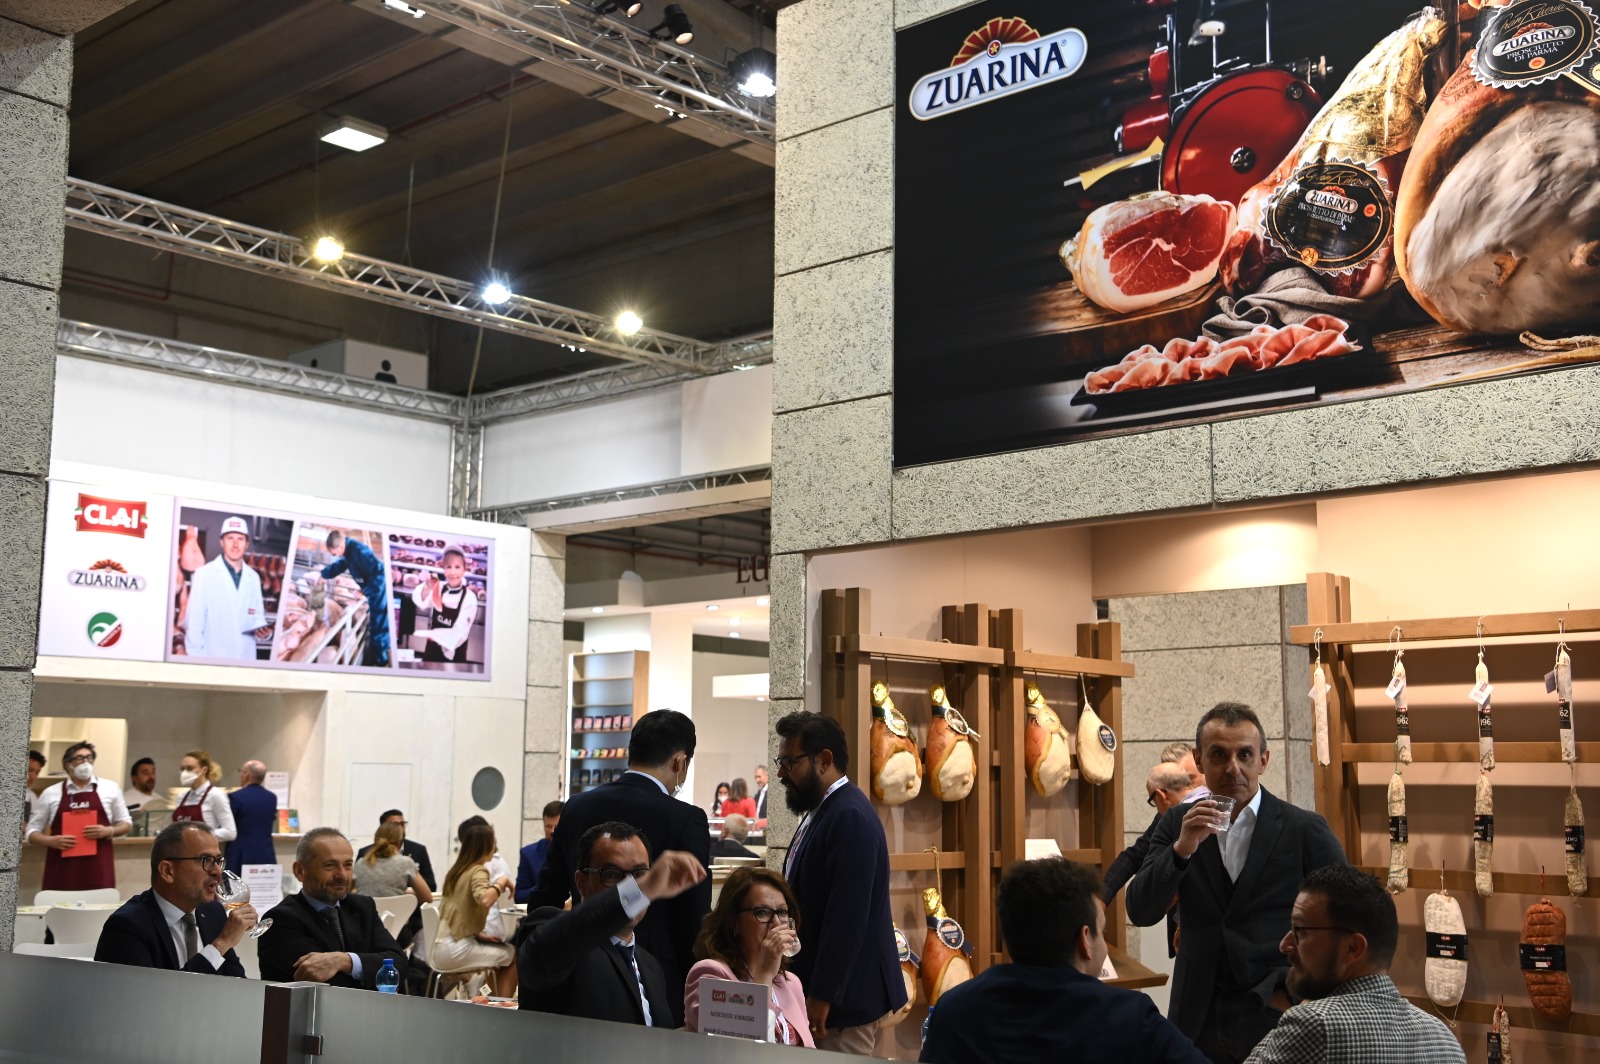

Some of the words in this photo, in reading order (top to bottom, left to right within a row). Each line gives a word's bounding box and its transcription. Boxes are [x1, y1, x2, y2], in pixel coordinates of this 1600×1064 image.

[1501, 28, 1566, 52] ZUARINA
[1507, 41, 1564, 59] PROSCIUTTO
[1514, 54, 1525, 62] DI
[1527, 46, 1558, 59] PARMA
[926, 41, 1067, 111] ZUARINA
[1310, 190, 1351, 211] ZUARINA
[83, 503, 139, 529] CLAI
[75, 572, 138, 590] ZUARINA
[1396, 717, 1409, 725] 962
[1480, 718, 1492, 726] 196
[1559, 709, 1569, 717] 62
